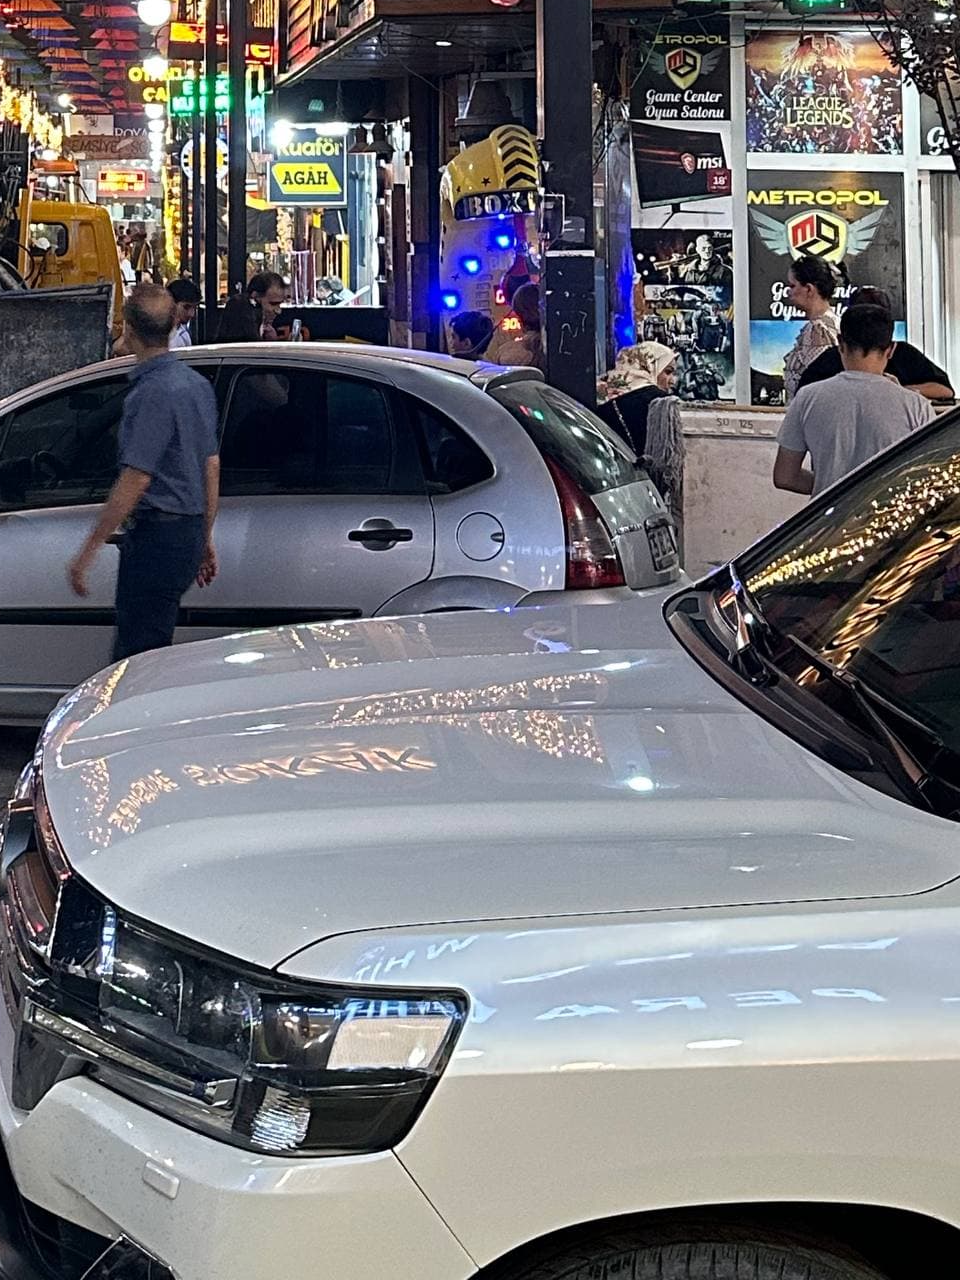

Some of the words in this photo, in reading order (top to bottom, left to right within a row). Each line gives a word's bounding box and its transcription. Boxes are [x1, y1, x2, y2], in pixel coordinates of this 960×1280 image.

[654, 34, 728, 44] ETROPOL
[646, 89, 682, 105] Game
[684, 89, 723, 102] Center
[793, 96, 842, 110] LEAGUE
[644, 106, 678, 120] Oyun
[680, 105, 725, 118] Salonu
[786, 107, 854, 128] LEGENDS
[697, 156, 723, 169] msi
[747, 190, 889, 205] METROPOL
